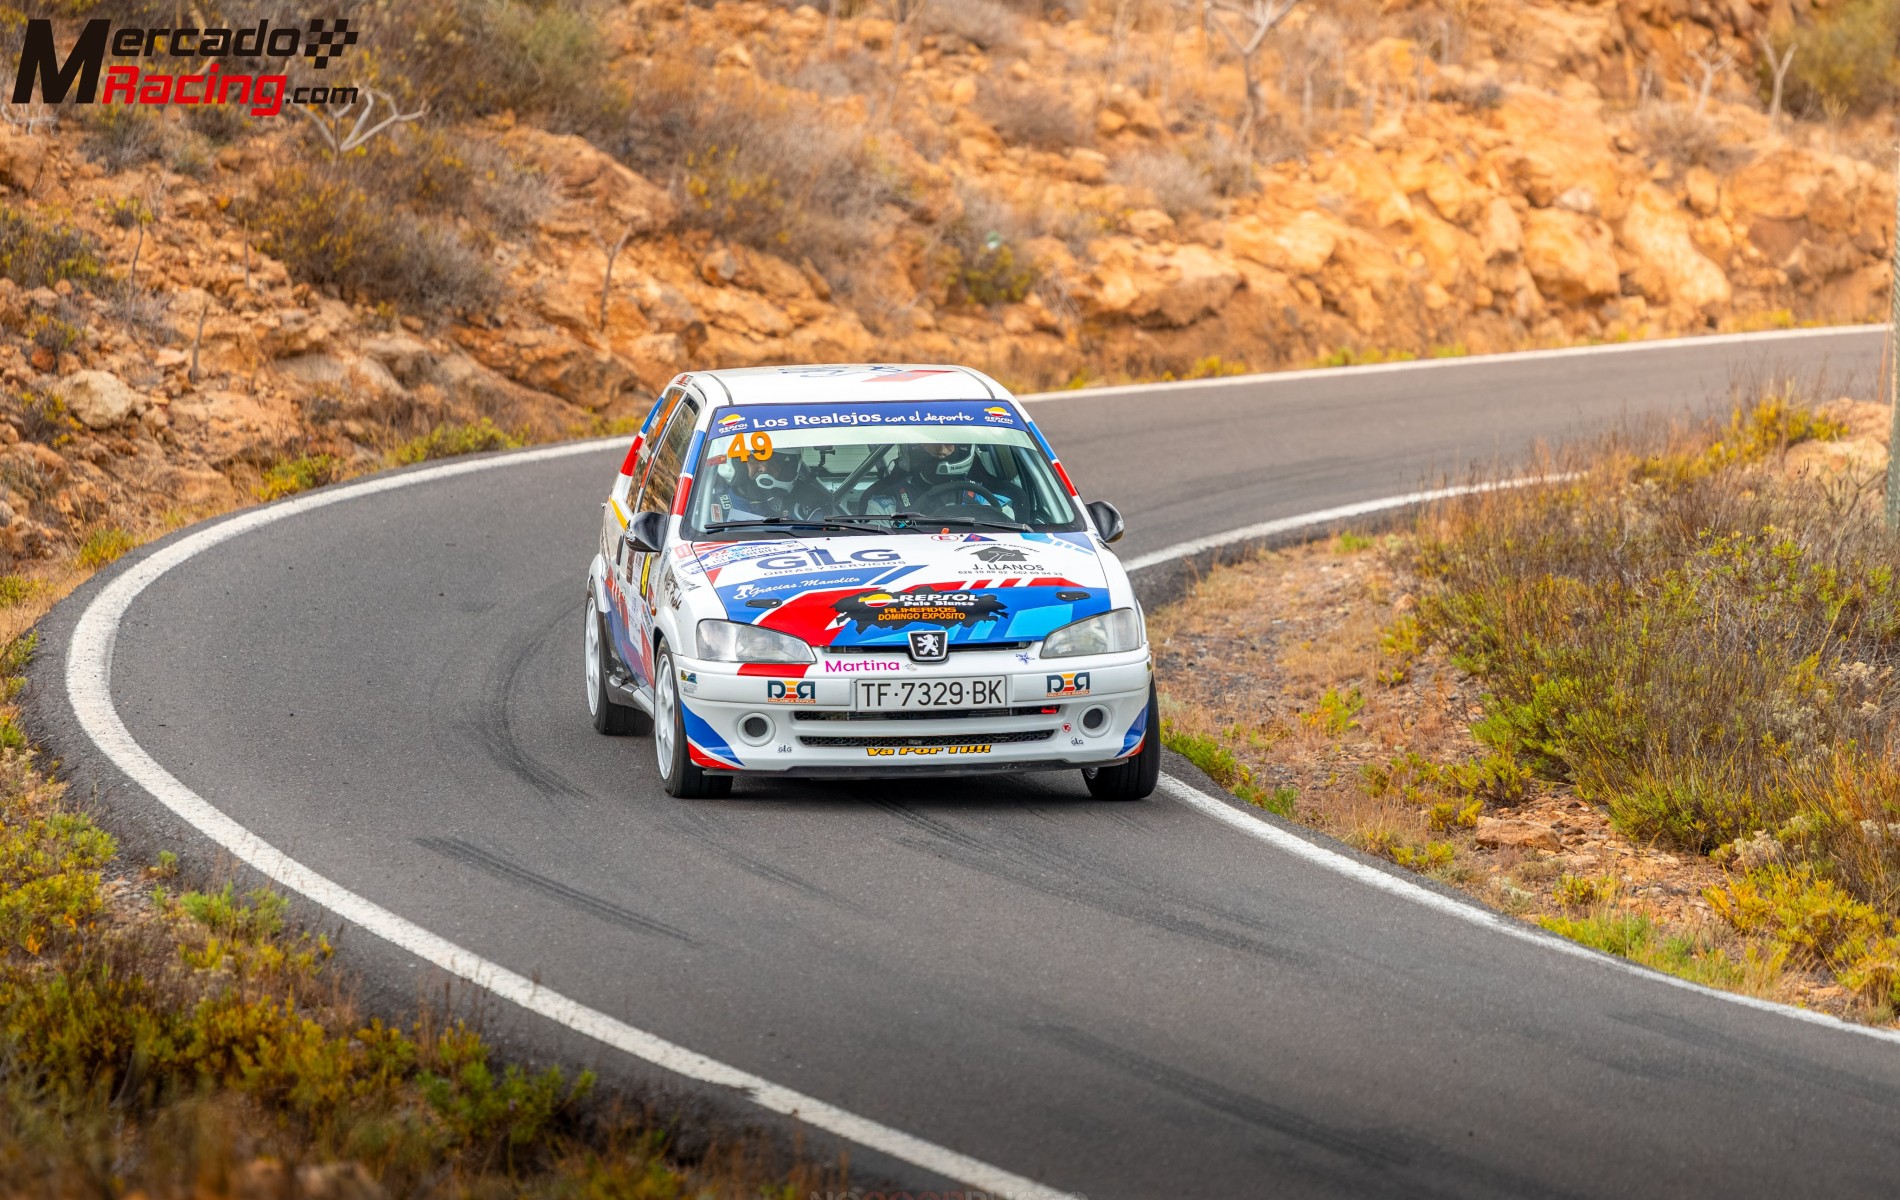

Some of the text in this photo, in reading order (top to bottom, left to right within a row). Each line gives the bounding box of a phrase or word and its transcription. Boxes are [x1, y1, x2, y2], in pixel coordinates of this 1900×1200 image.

[753, 418, 788, 429] Los
[794, 412, 881, 425] Realejos
[909, 410, 920, 422] el
[923, 411, 975, 424] deporte
[727, 431, 774, 462] 49
[972, 563, 1045, 572] J. LLANOS
[899, 594, 979, 602] REPSOL
[878, 612, 920, 621] DOMINGO
[825, 660, 900, 673] Martina
[866, 747, 895, 756] Va
[899, 746, 943, 756] Por
